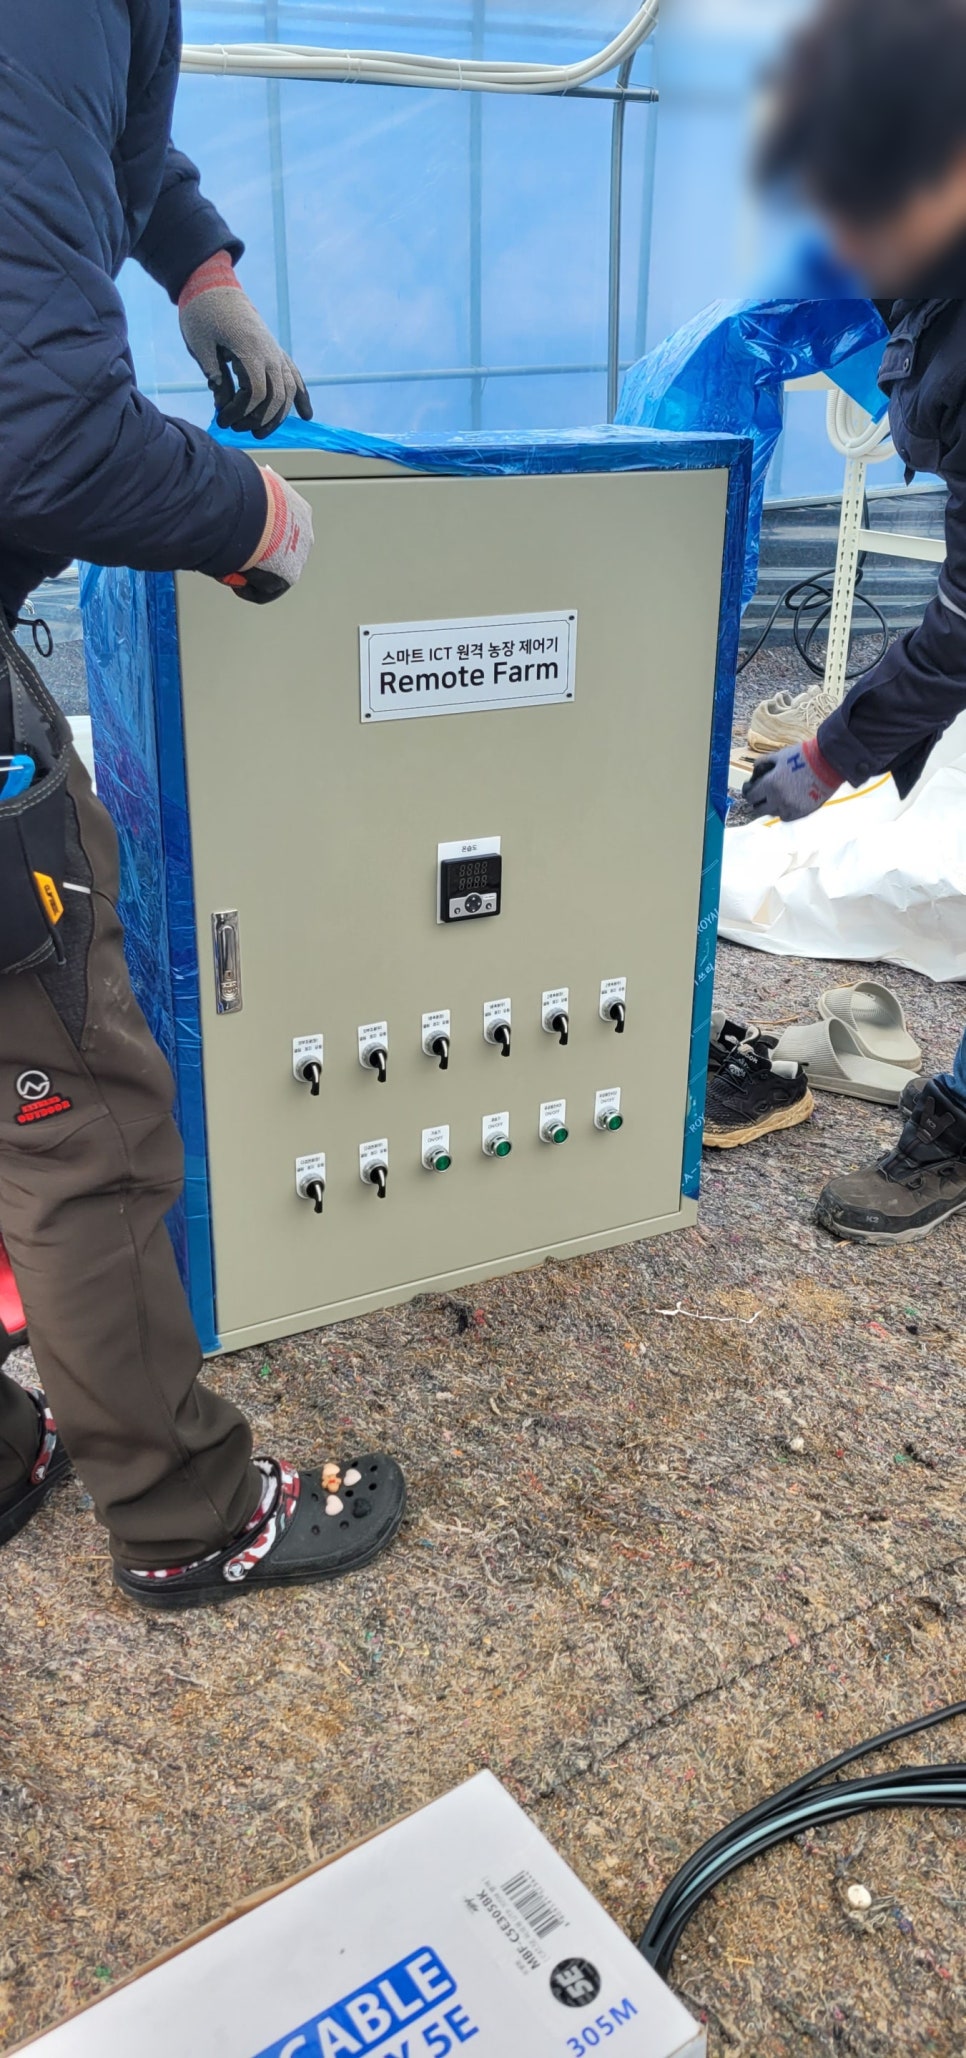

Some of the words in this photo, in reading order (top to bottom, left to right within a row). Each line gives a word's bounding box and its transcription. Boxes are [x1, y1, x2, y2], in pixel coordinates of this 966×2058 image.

[381, 648, 425, 666] 스마트
[429, 647, 453, 661] ICT
[456, 643, 484, 661] 원격
[487, 640, 516, 658] 농장
[518, 636, 559, 655] 제어기
[380, 666, 485, 694] Remote
[493, 661, 559, 684] Farm
[556, 1964, 594, 1999] 5E
[422, 2004, 479, 2058] 5E
[566, 1997, 638, 2058] 305M
